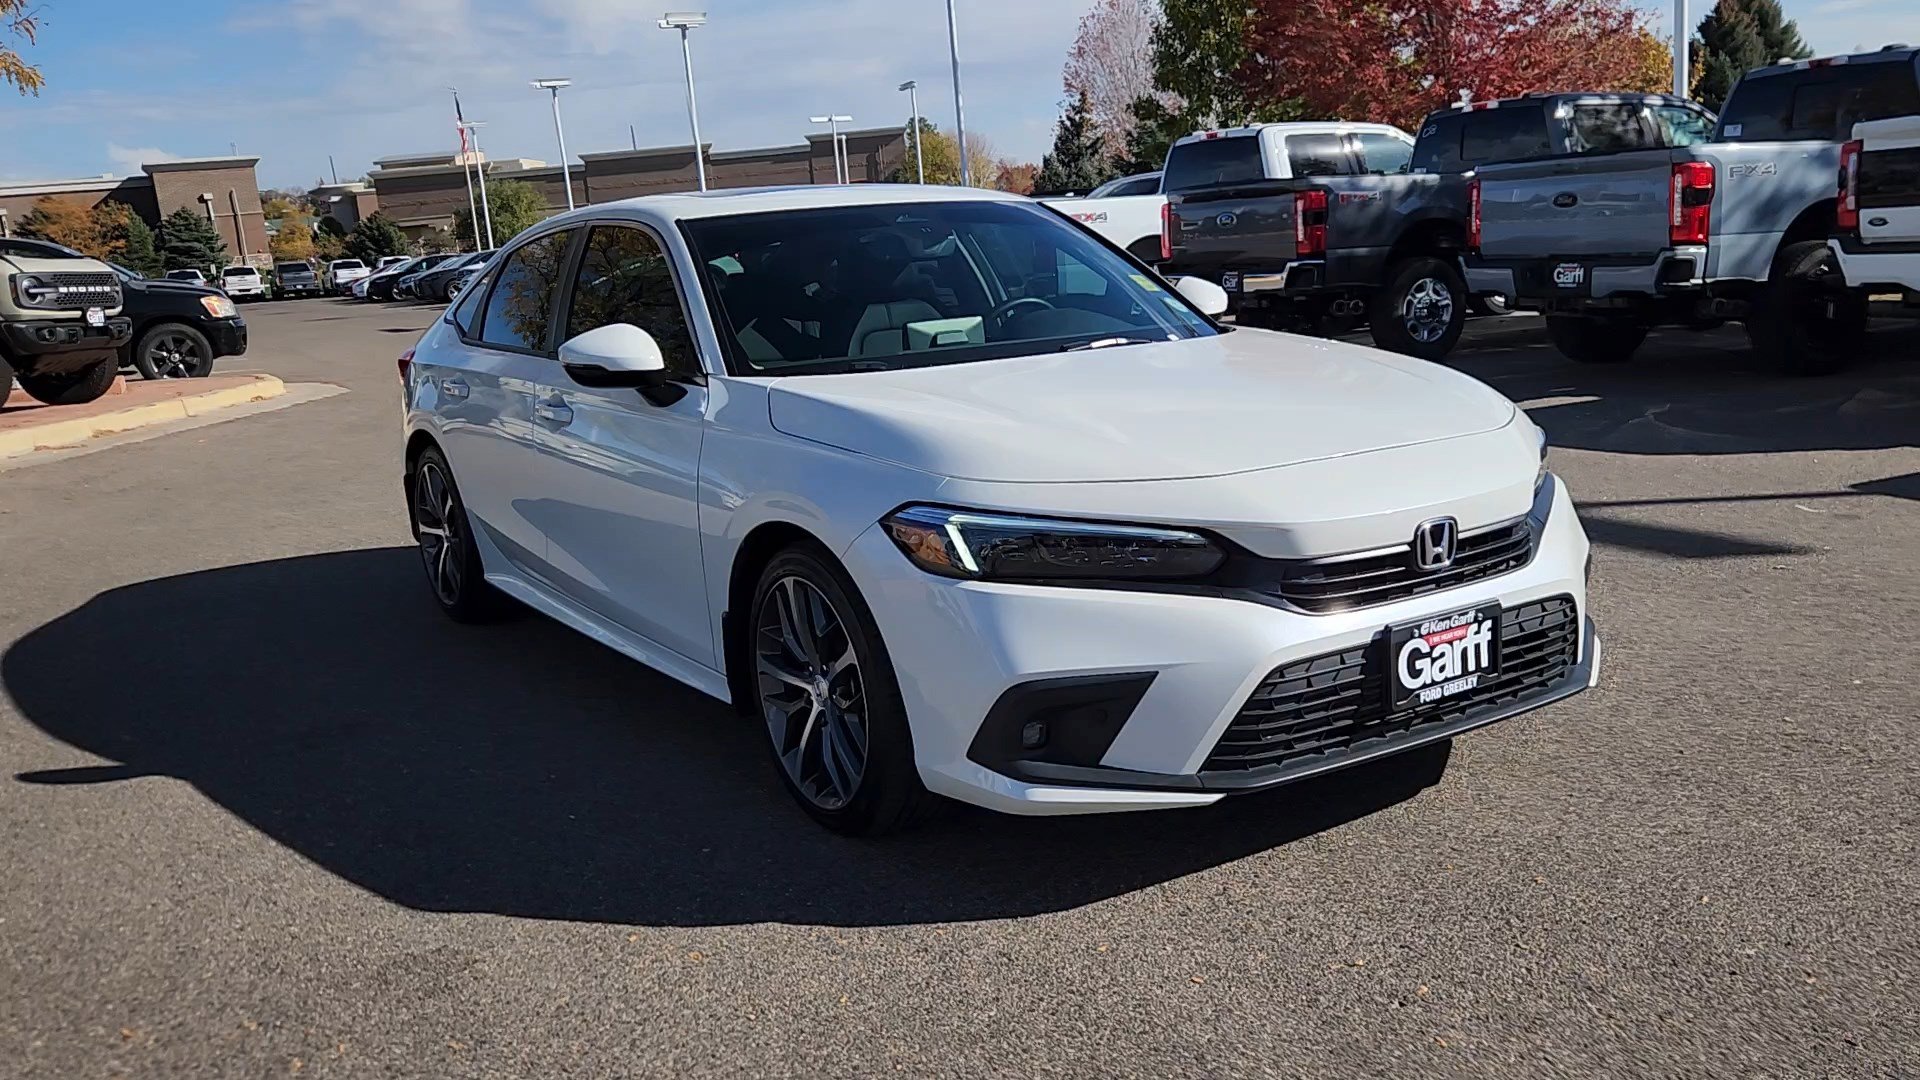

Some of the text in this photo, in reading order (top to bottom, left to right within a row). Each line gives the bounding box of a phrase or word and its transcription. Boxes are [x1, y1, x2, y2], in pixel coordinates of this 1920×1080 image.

[1728, 162, 1777, 180] FX4
[1554, 267, 1584, 283] Garff
[1430, 610, 1476, 634] Ken Garff
[1398, 619, 1492, 689] Garff
[1420, 676, 1478, 703] FORD GREELEY
